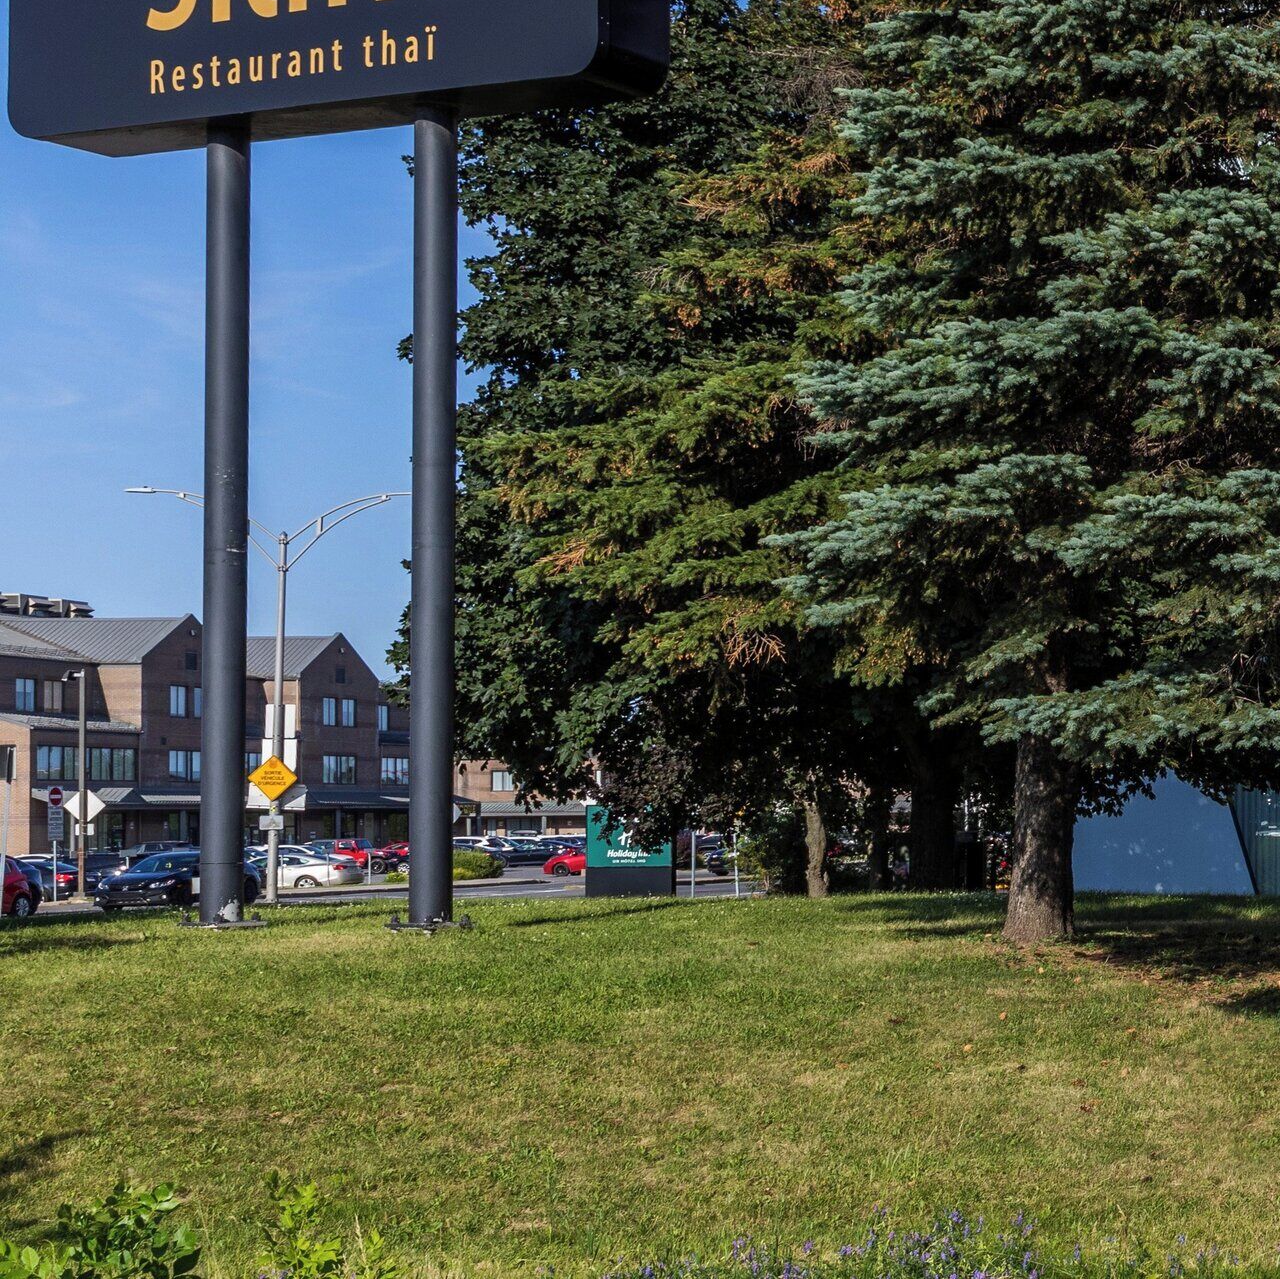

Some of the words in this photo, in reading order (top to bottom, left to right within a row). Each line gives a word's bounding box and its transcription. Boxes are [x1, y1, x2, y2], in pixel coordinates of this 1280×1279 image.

[150, 39, 342, 94] Restaurant
[364, 25, 437, 68] thaï
[607, 849, 637, 858] Holiday
